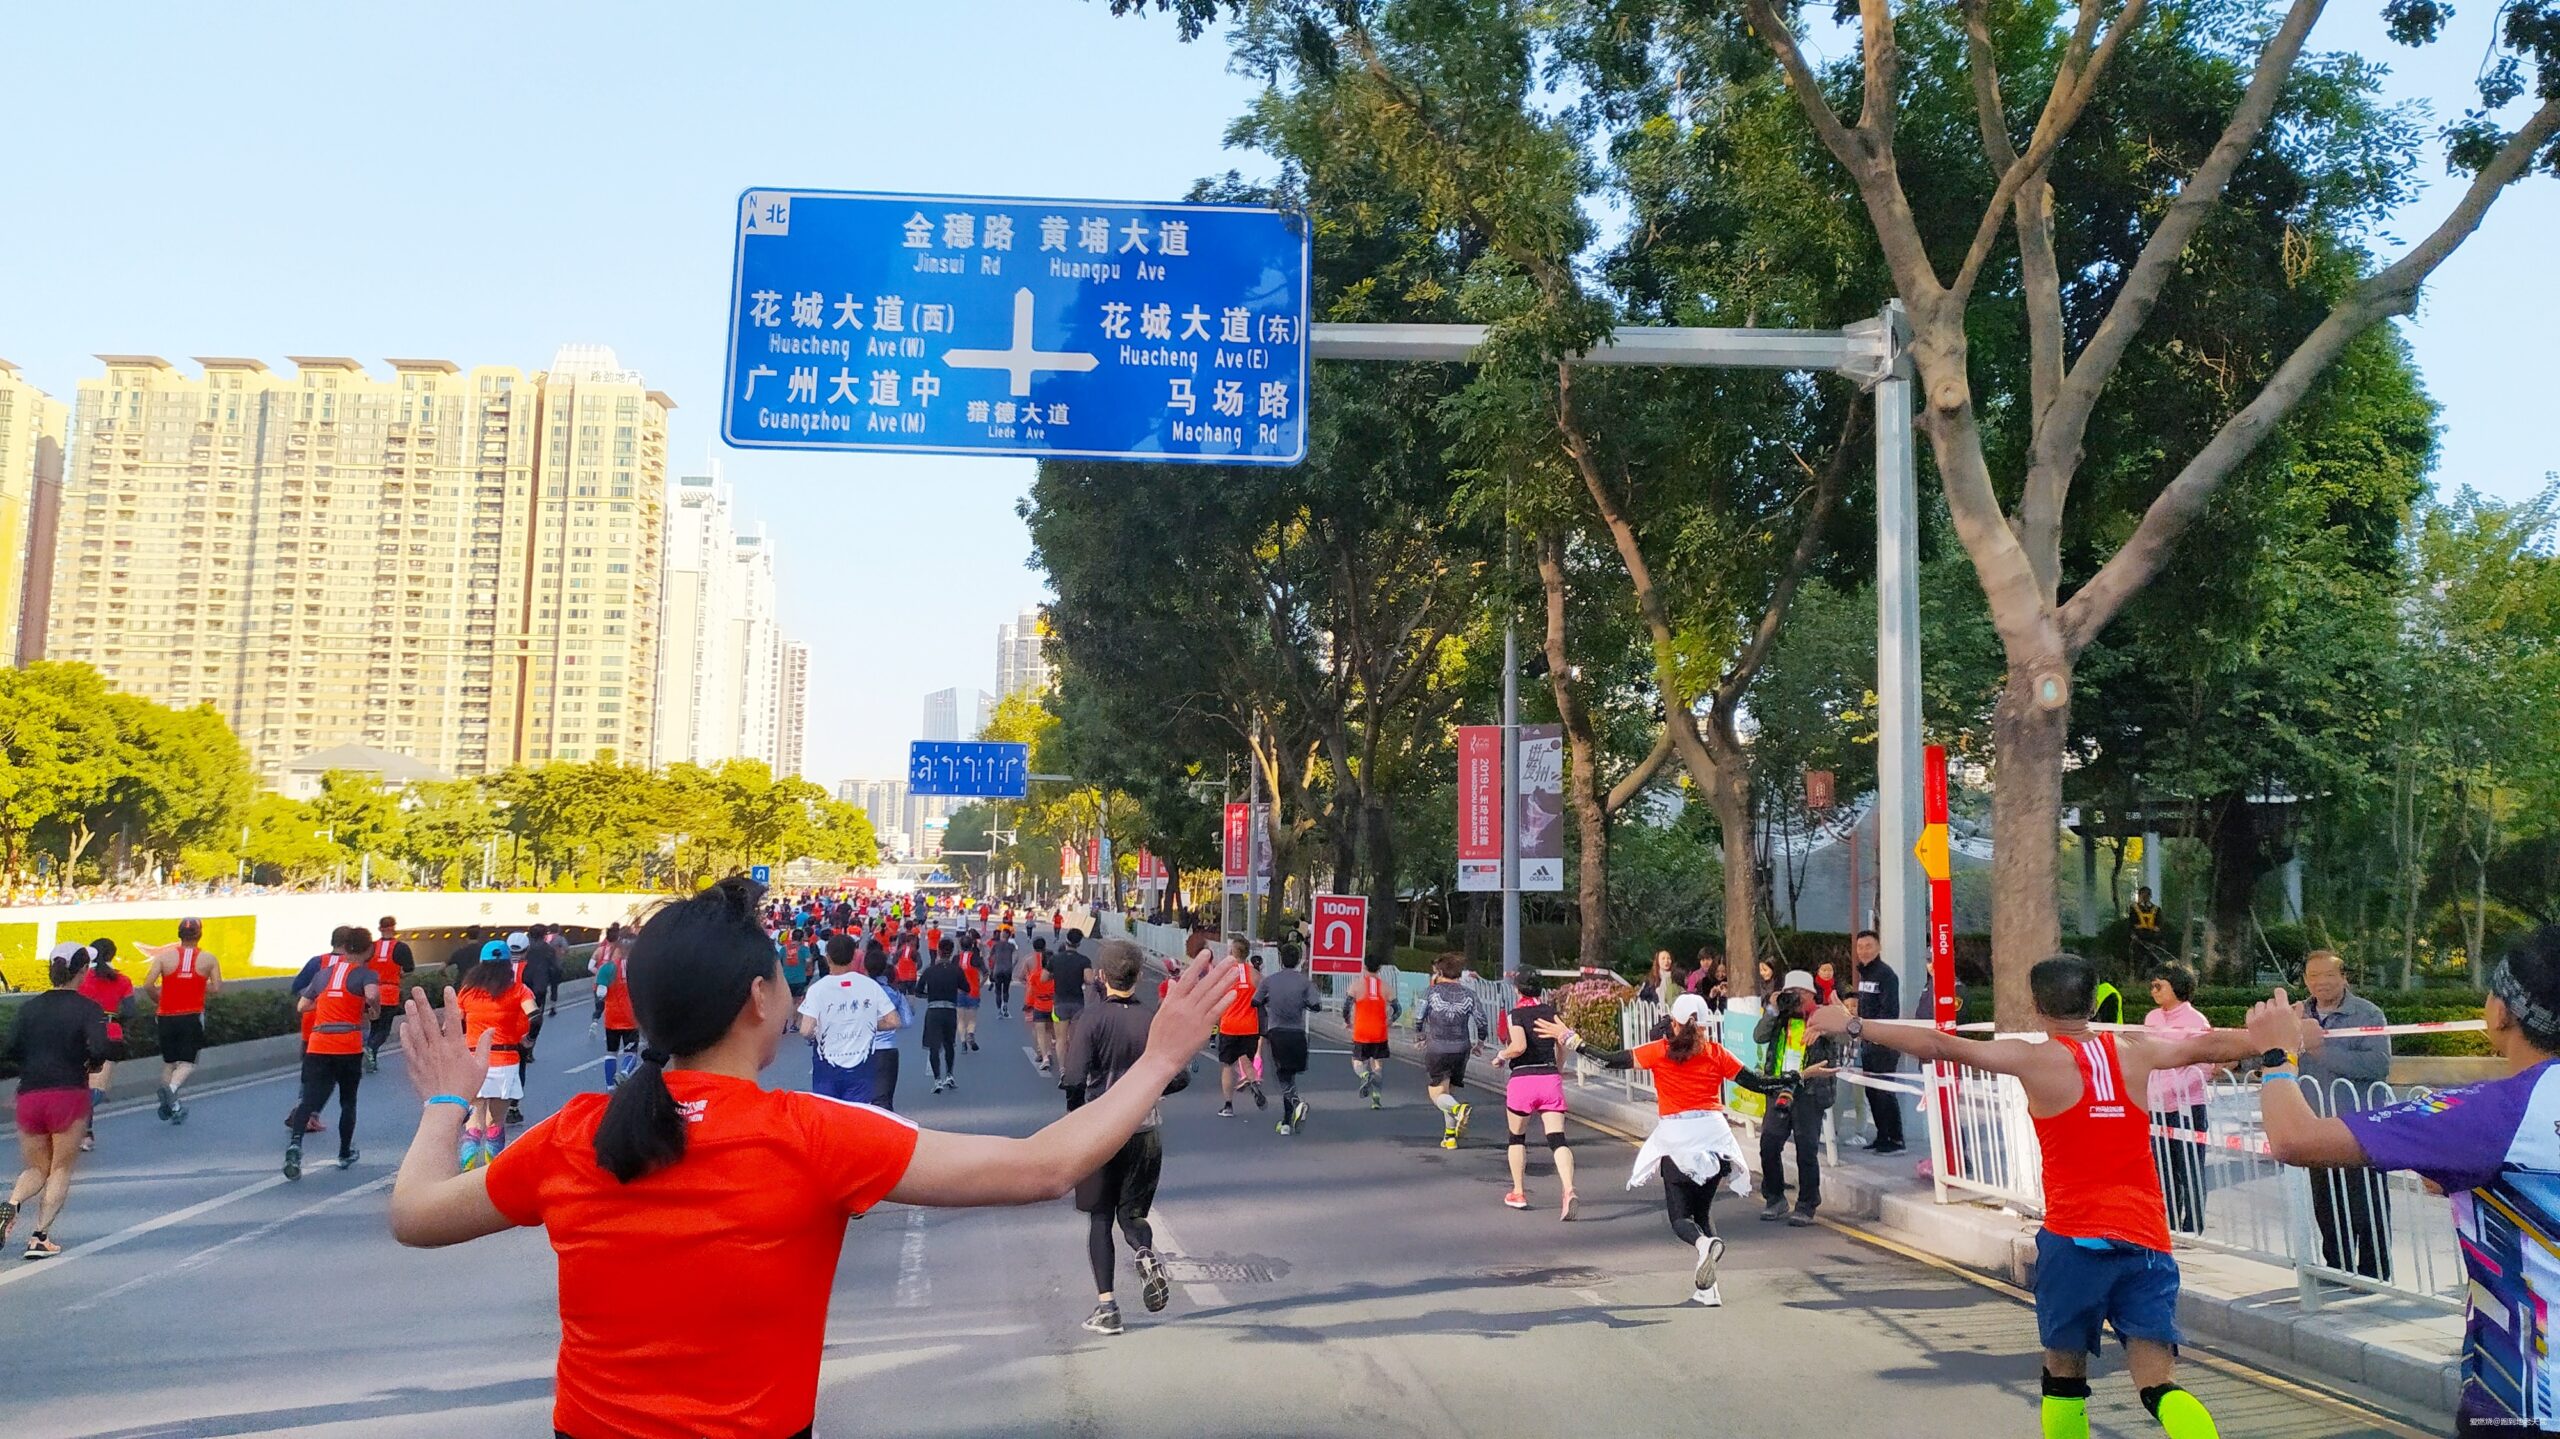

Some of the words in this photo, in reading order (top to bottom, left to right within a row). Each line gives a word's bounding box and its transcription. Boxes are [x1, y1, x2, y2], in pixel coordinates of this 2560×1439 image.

[765, 203, 787, 223] 北
[902, 211, 1015, 251] 金穗路
[1039, 215, 1190, 257] 黄埔大道
[912, 252, 965, 275] Jinsui
[980, 255, 1001, 276] Rd
[1050, 257, 1121, 285] Huangpu
[1136, 261, 1166, 281] Ave
[750, 289, 955, 334] 花城大道(西)
[1100, 301, 1300, 345] 花城大道(东)
[769, 333, 850, 362] Huacheng
[1119, 344, 1198, 373] Huacheng
[744, 364, 941, 408] 广州大道中
[1167, 378, 1290, 420] 马场路
[758, 407, 850, 436] Guangzhou
[988, 424, 1016, 438] Liede
[1026, 426, 1046, 440] Ave
[1172, 420, 1242, 450] Machang
[1259, 423, 1278, 444] Rd
[1323, 902, 1360, 916] 100m
[1938, 923, 1949, 955] Liede
